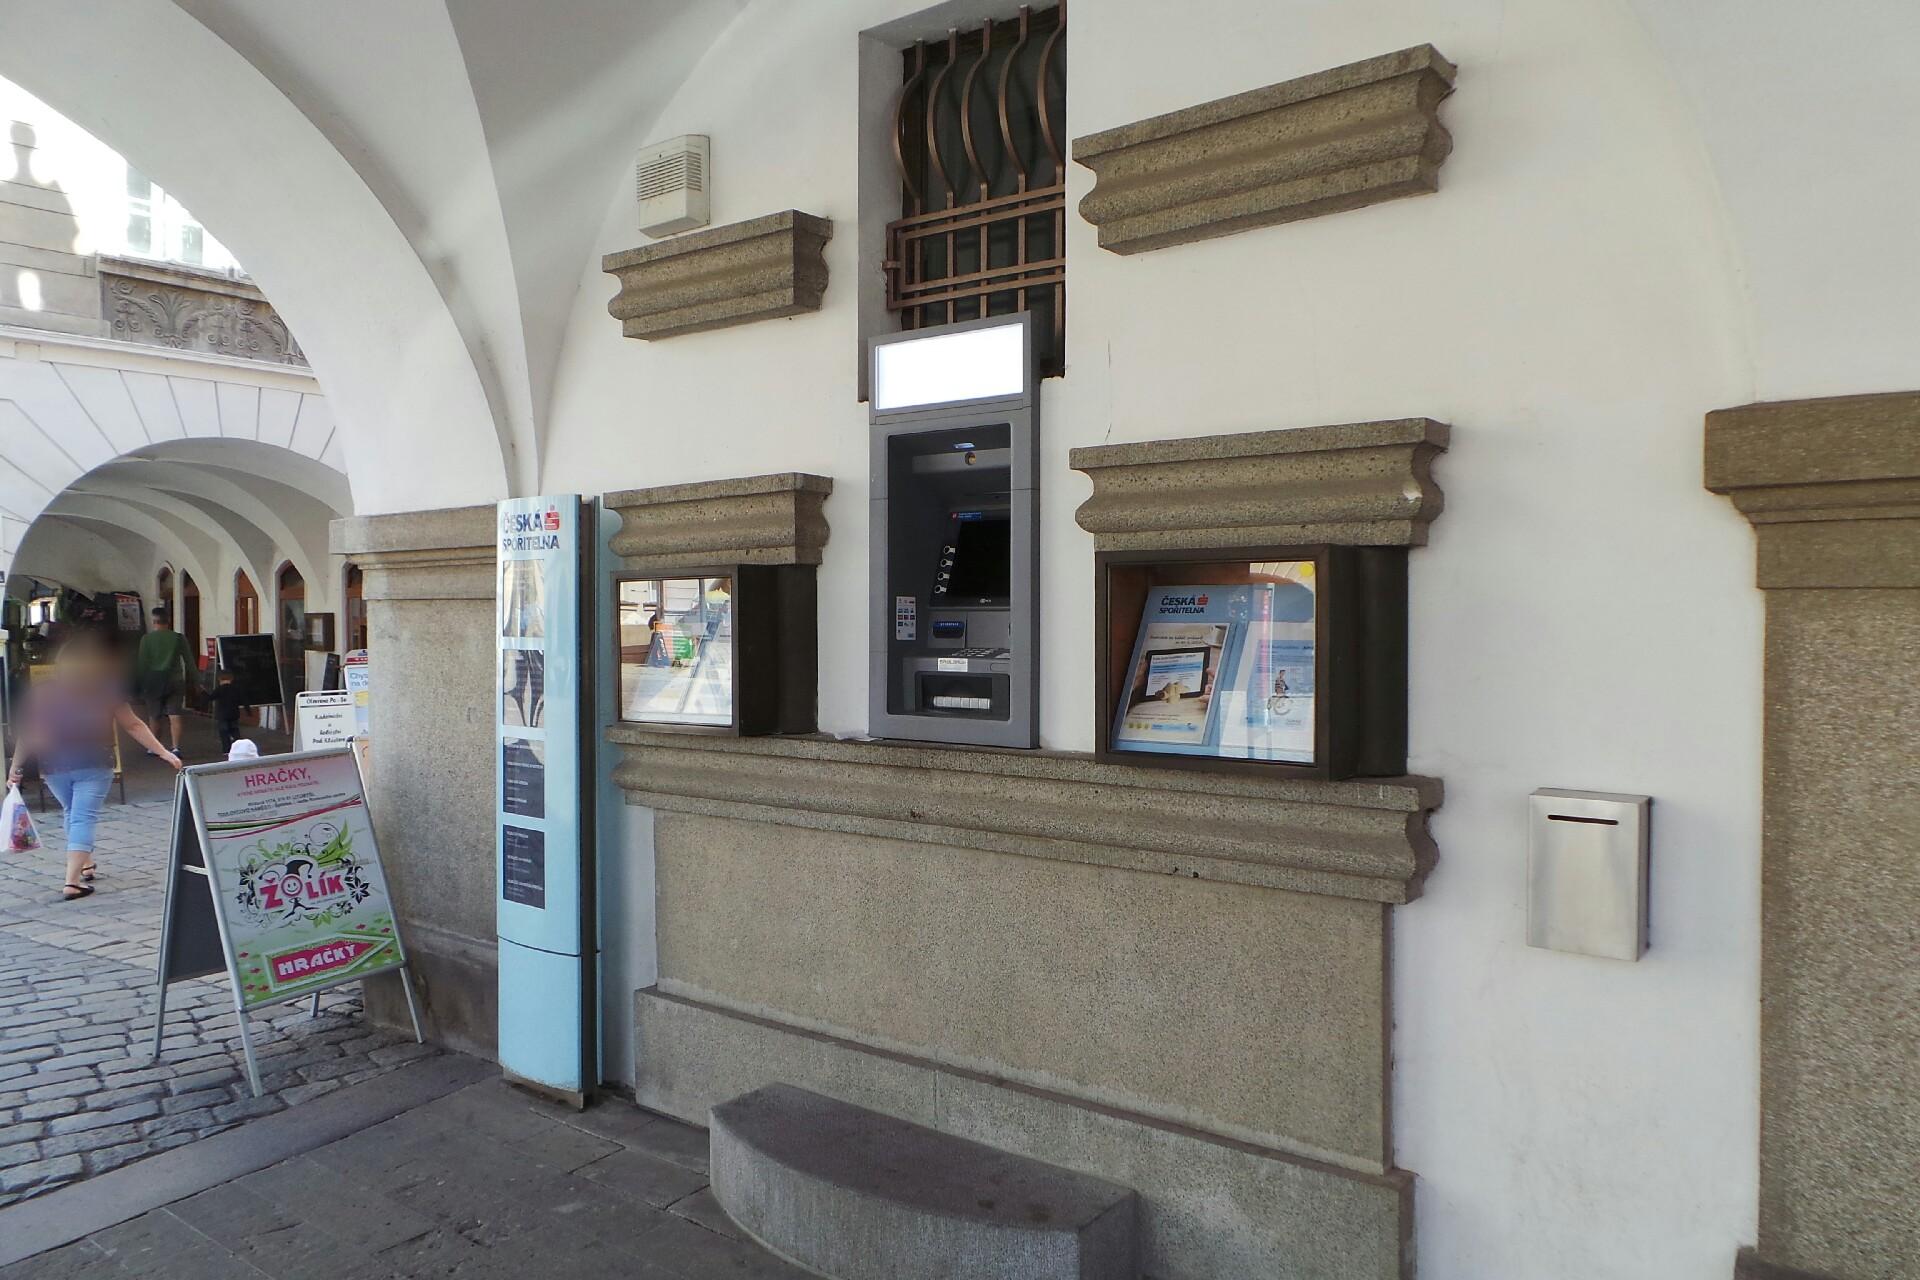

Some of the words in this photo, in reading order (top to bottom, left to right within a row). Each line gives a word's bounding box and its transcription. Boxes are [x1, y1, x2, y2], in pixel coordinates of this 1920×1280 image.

[503, 534, 560, 551] SPOŘITELNA
[1161, 594, 1196, 606] ČESKÁ
[1159, 605, 1205, 614] SPOŘITELNA
[245, 767, 311, 788] HRAČKY,
[278, 944, 355, 976] HRAČKY
